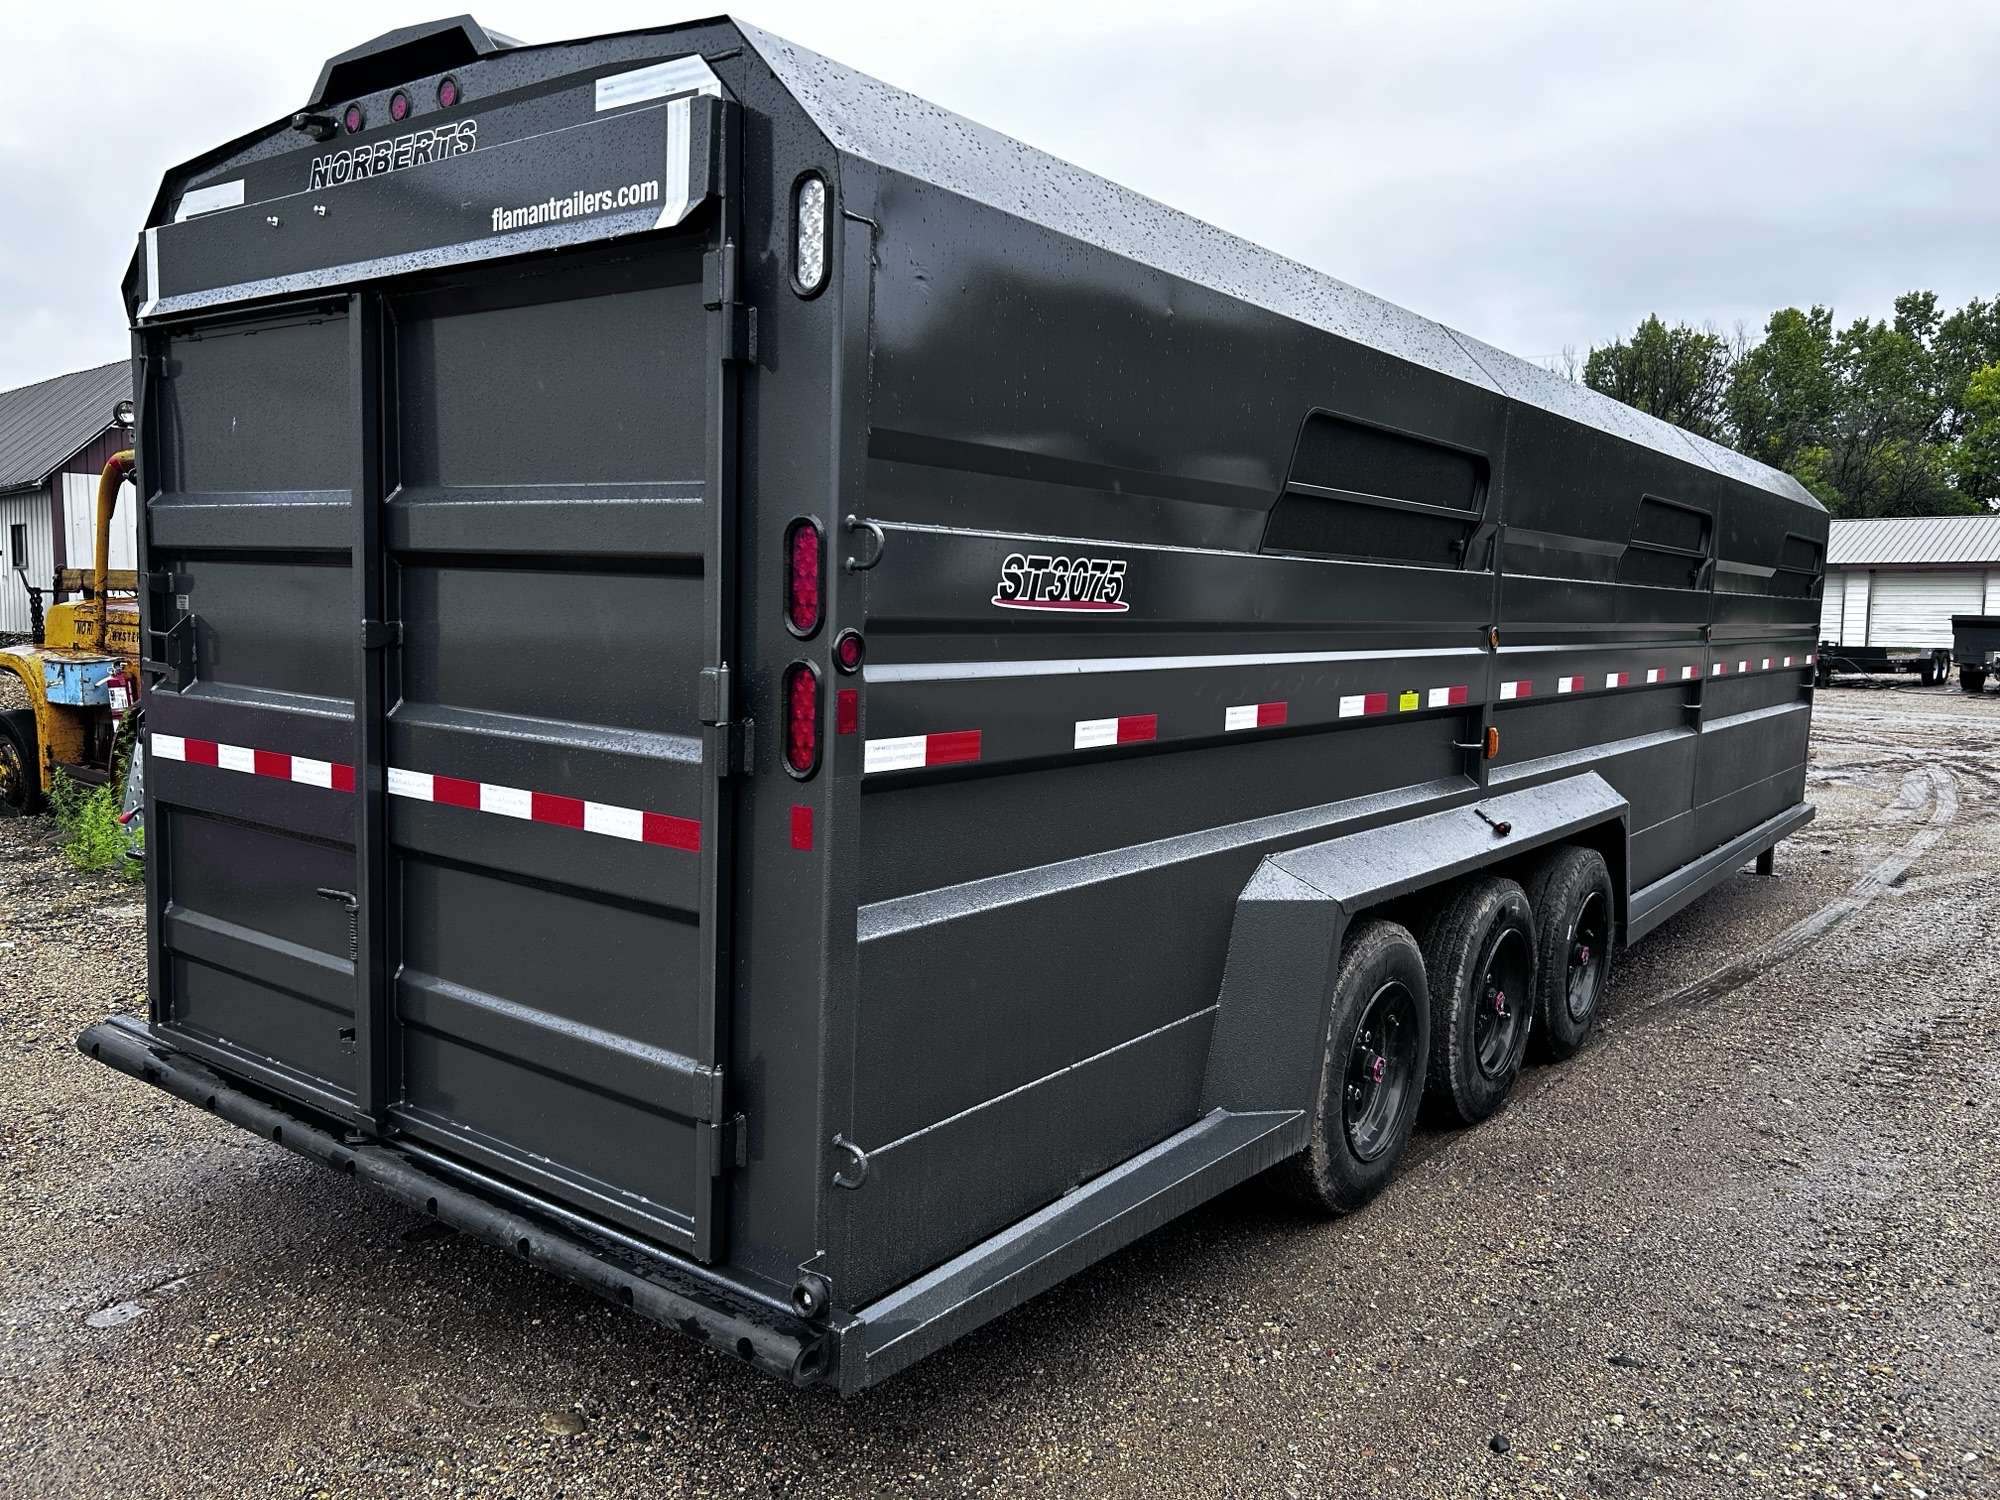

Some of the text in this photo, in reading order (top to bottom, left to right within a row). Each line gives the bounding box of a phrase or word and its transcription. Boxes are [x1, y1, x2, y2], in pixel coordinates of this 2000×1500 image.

[310, 119, 478, 191] NORBERTS
[491, 179, 659, 232] flamantrailers.com
[997, 553, 1127, 603] ST3075
